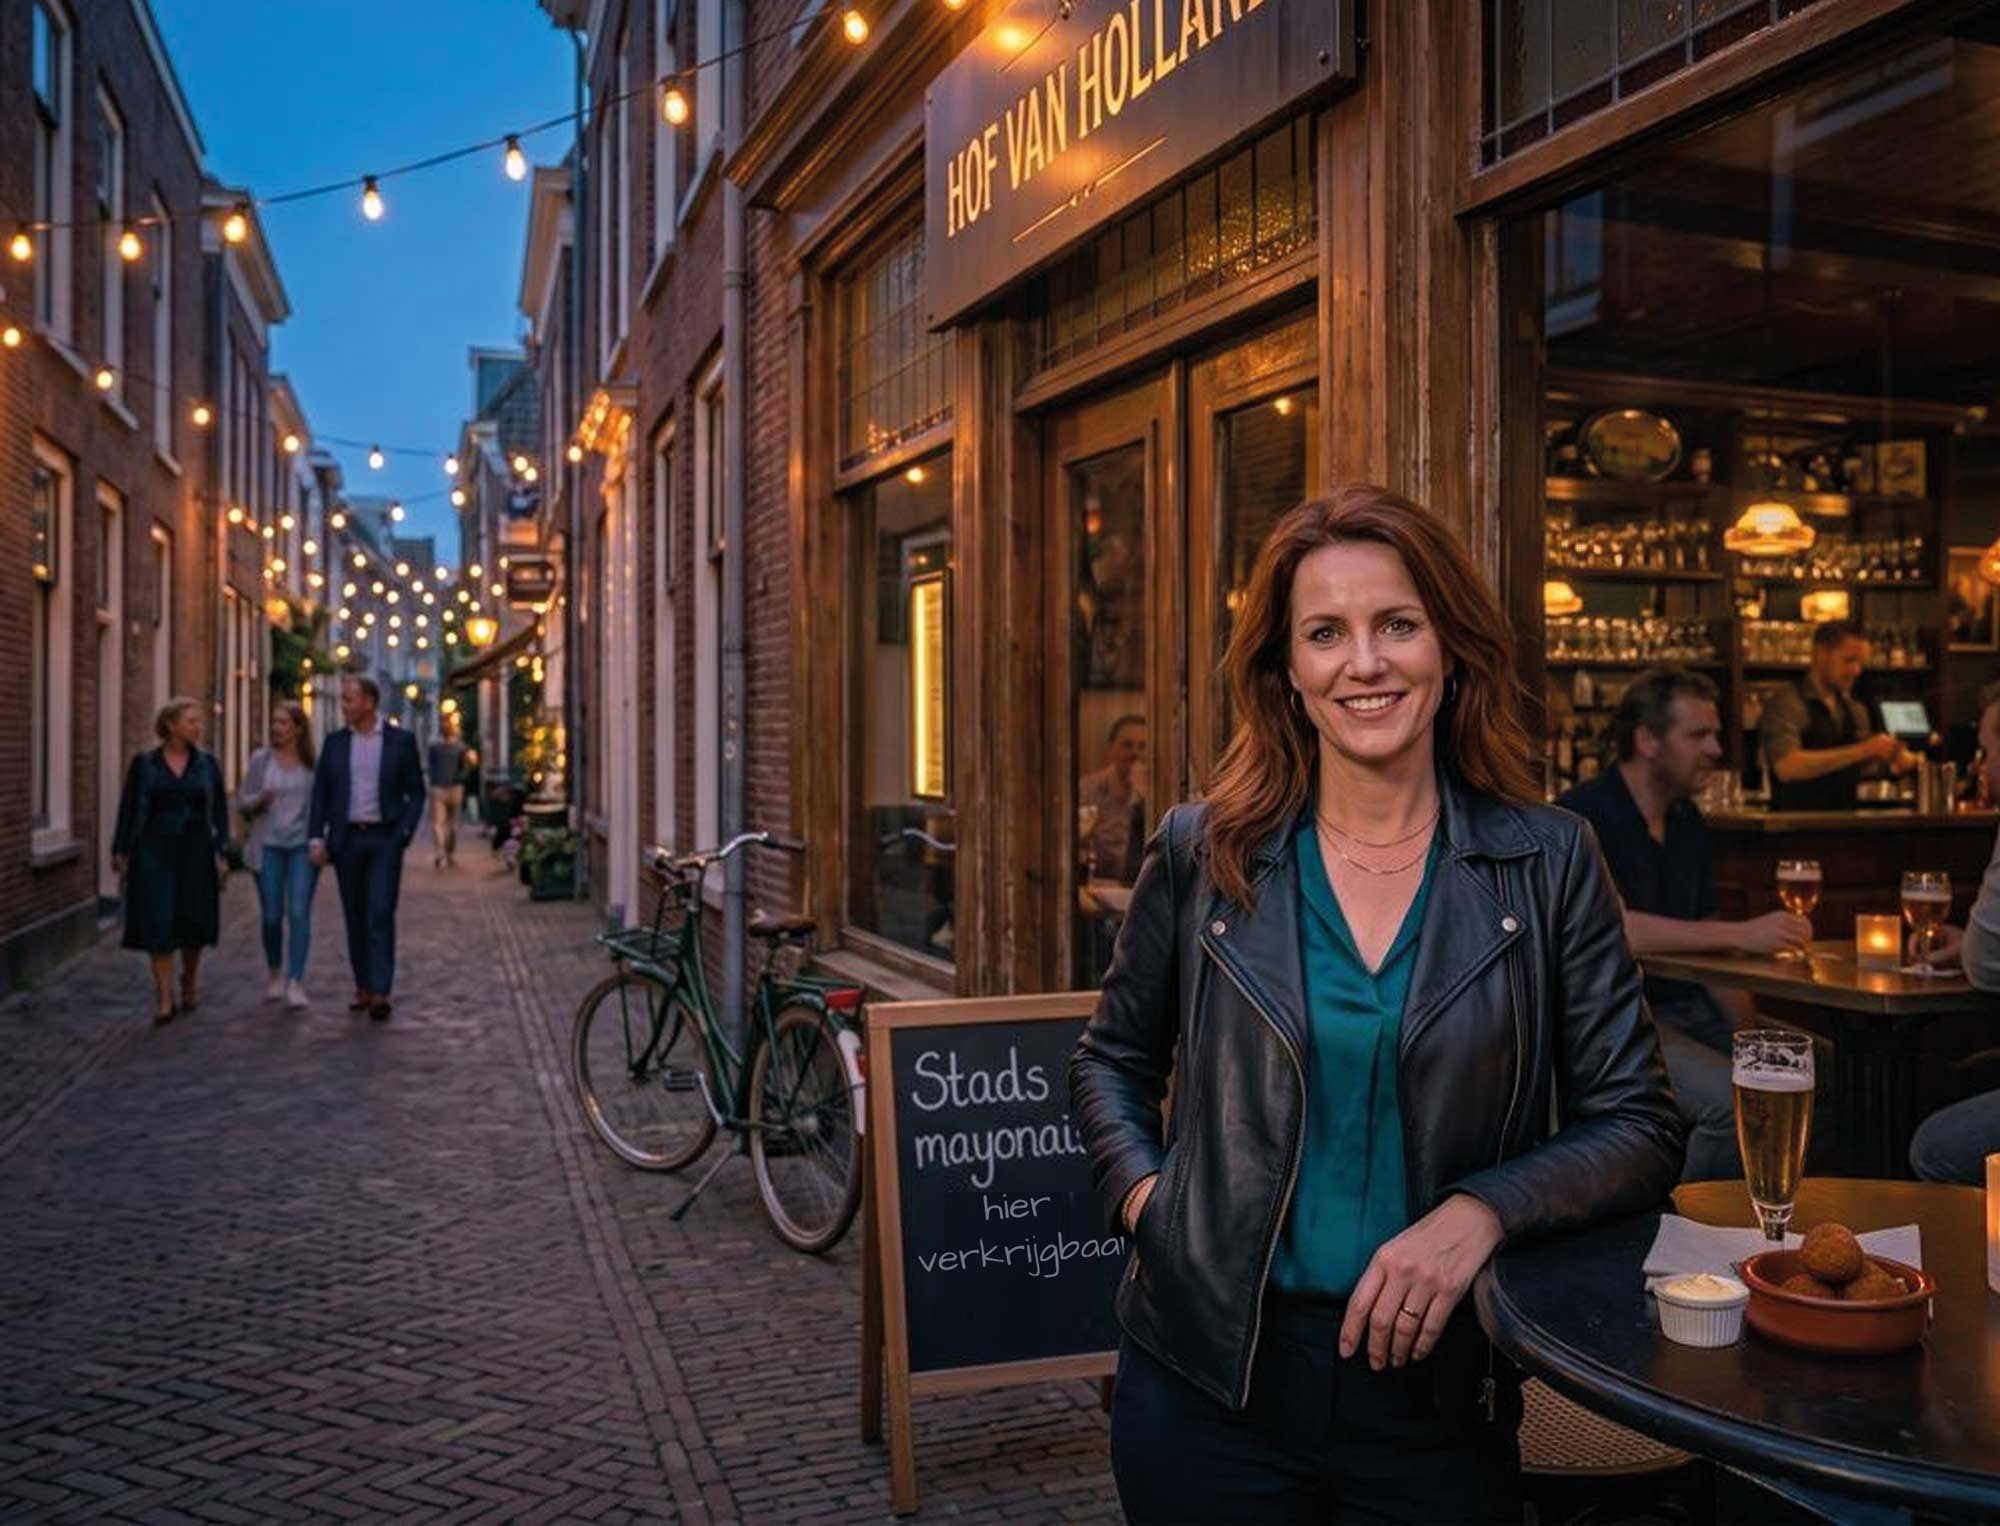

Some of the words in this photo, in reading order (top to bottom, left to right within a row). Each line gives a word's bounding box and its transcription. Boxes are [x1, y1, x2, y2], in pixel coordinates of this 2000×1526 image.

[946, 123, 998, 238] HOF
[1005, 64, 1068, 191] VAN
[1078, 0, 1264, 140] HOLLA
[912, 1046, 1050, 1111] Stads
[982, 1193, 1051, 1221] hier
